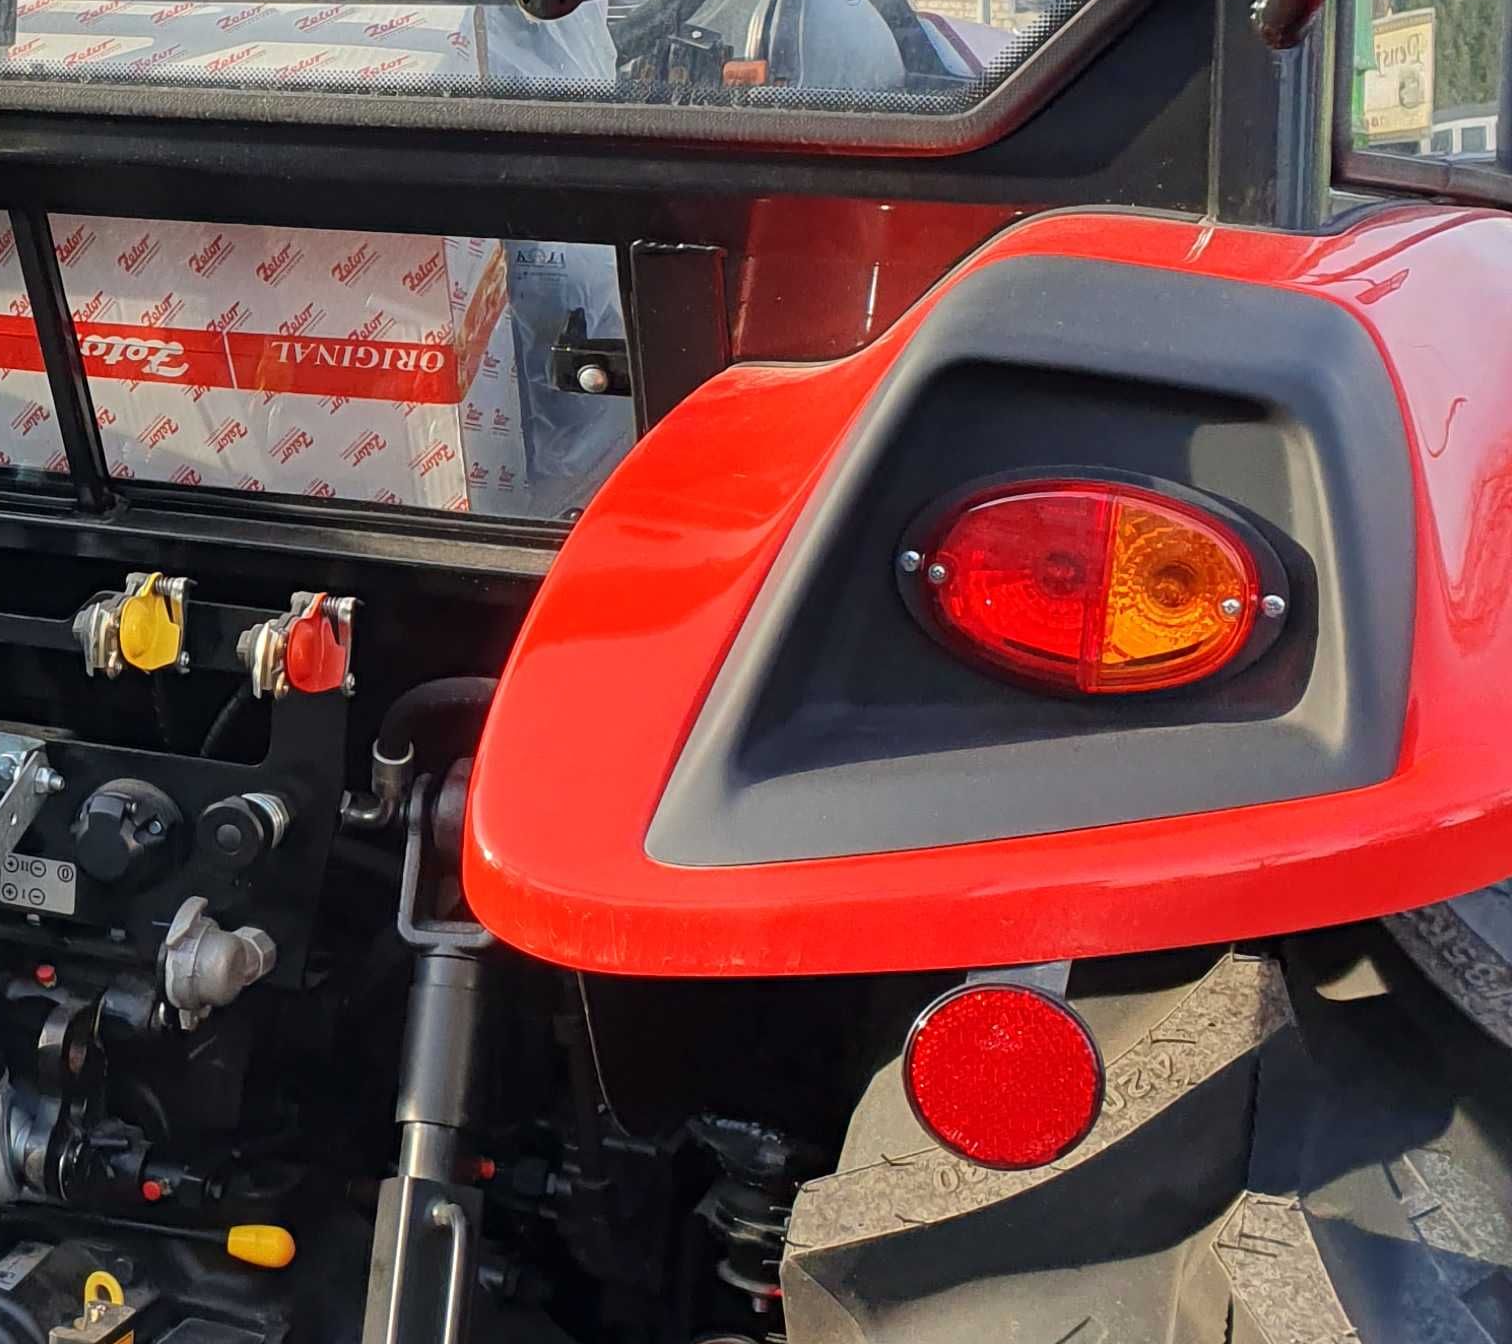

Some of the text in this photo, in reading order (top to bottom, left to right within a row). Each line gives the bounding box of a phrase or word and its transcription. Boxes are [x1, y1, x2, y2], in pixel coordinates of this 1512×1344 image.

[364, 12, 418, 37] Zetor
[80, 335, 188, 377] Zeto
[272, 341, 445, 373] ORIGINAL
